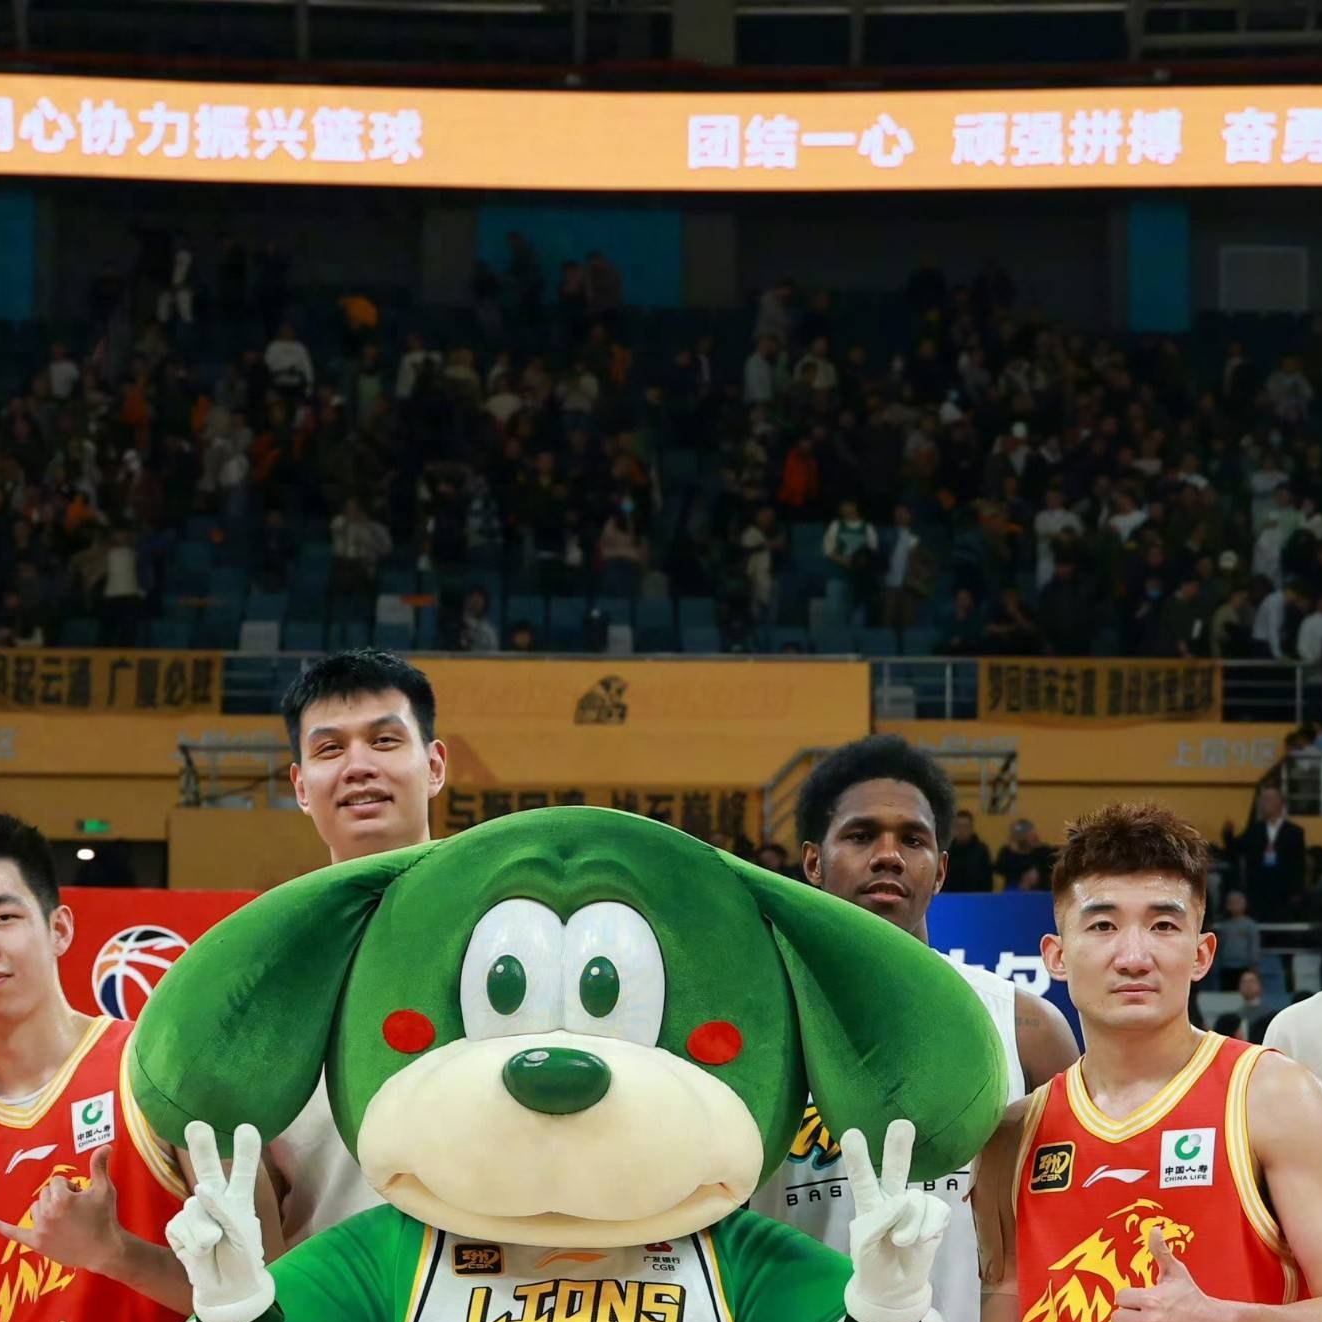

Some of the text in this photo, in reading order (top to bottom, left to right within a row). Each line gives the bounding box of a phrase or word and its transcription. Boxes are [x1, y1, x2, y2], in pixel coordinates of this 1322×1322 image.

[687, 113, 915, 169] 团结一心
[951, 108, 1183, 166] 顽强拼搏
[77, 1125, 111, 1141] 中国人寿
[1165, 1164, 1208, 1175] 中国人寿
[1164, 1175, 1188, 1183] CHINA
[643, 1255, 680, 1264] 广发银行
[652, 1264, 676, 1272] CGB
